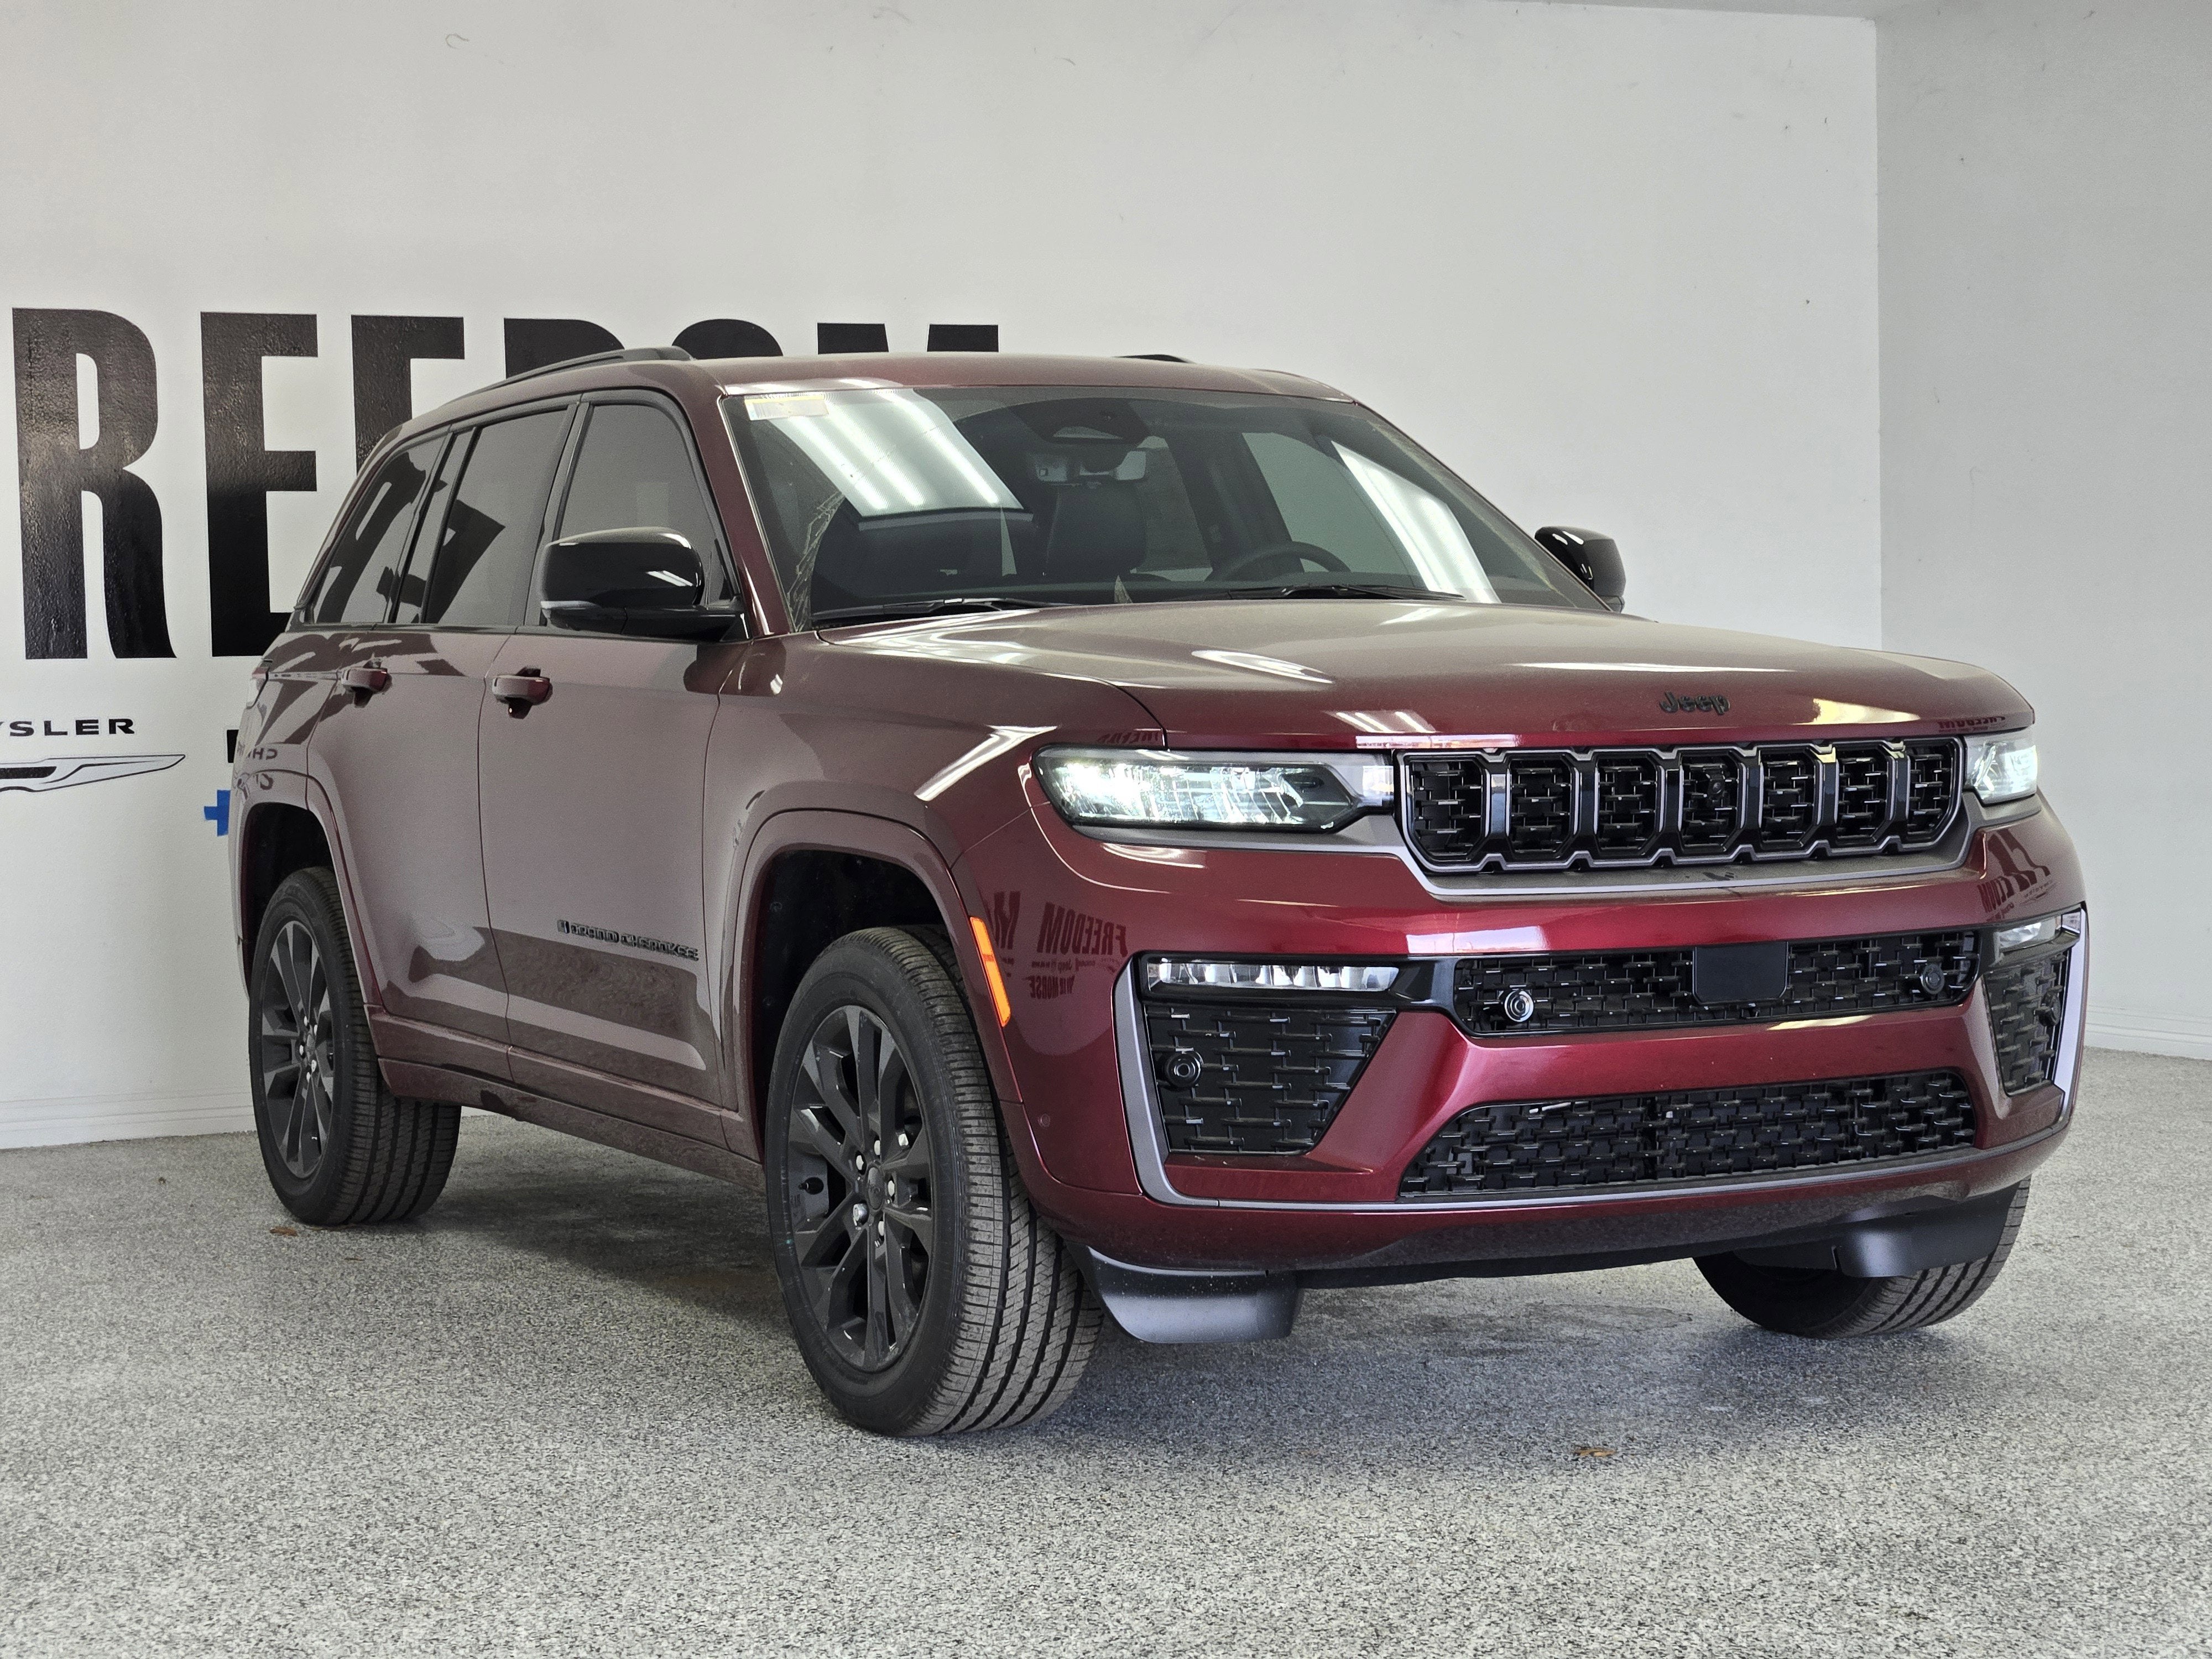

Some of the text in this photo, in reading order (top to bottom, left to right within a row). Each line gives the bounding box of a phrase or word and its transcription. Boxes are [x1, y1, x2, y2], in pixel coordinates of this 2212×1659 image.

[1660, 691, 1730, 715] Jeep
[0, 718, 134, 737] SLER
[570, 922, 699, 961] GRAND CHEROKEE
